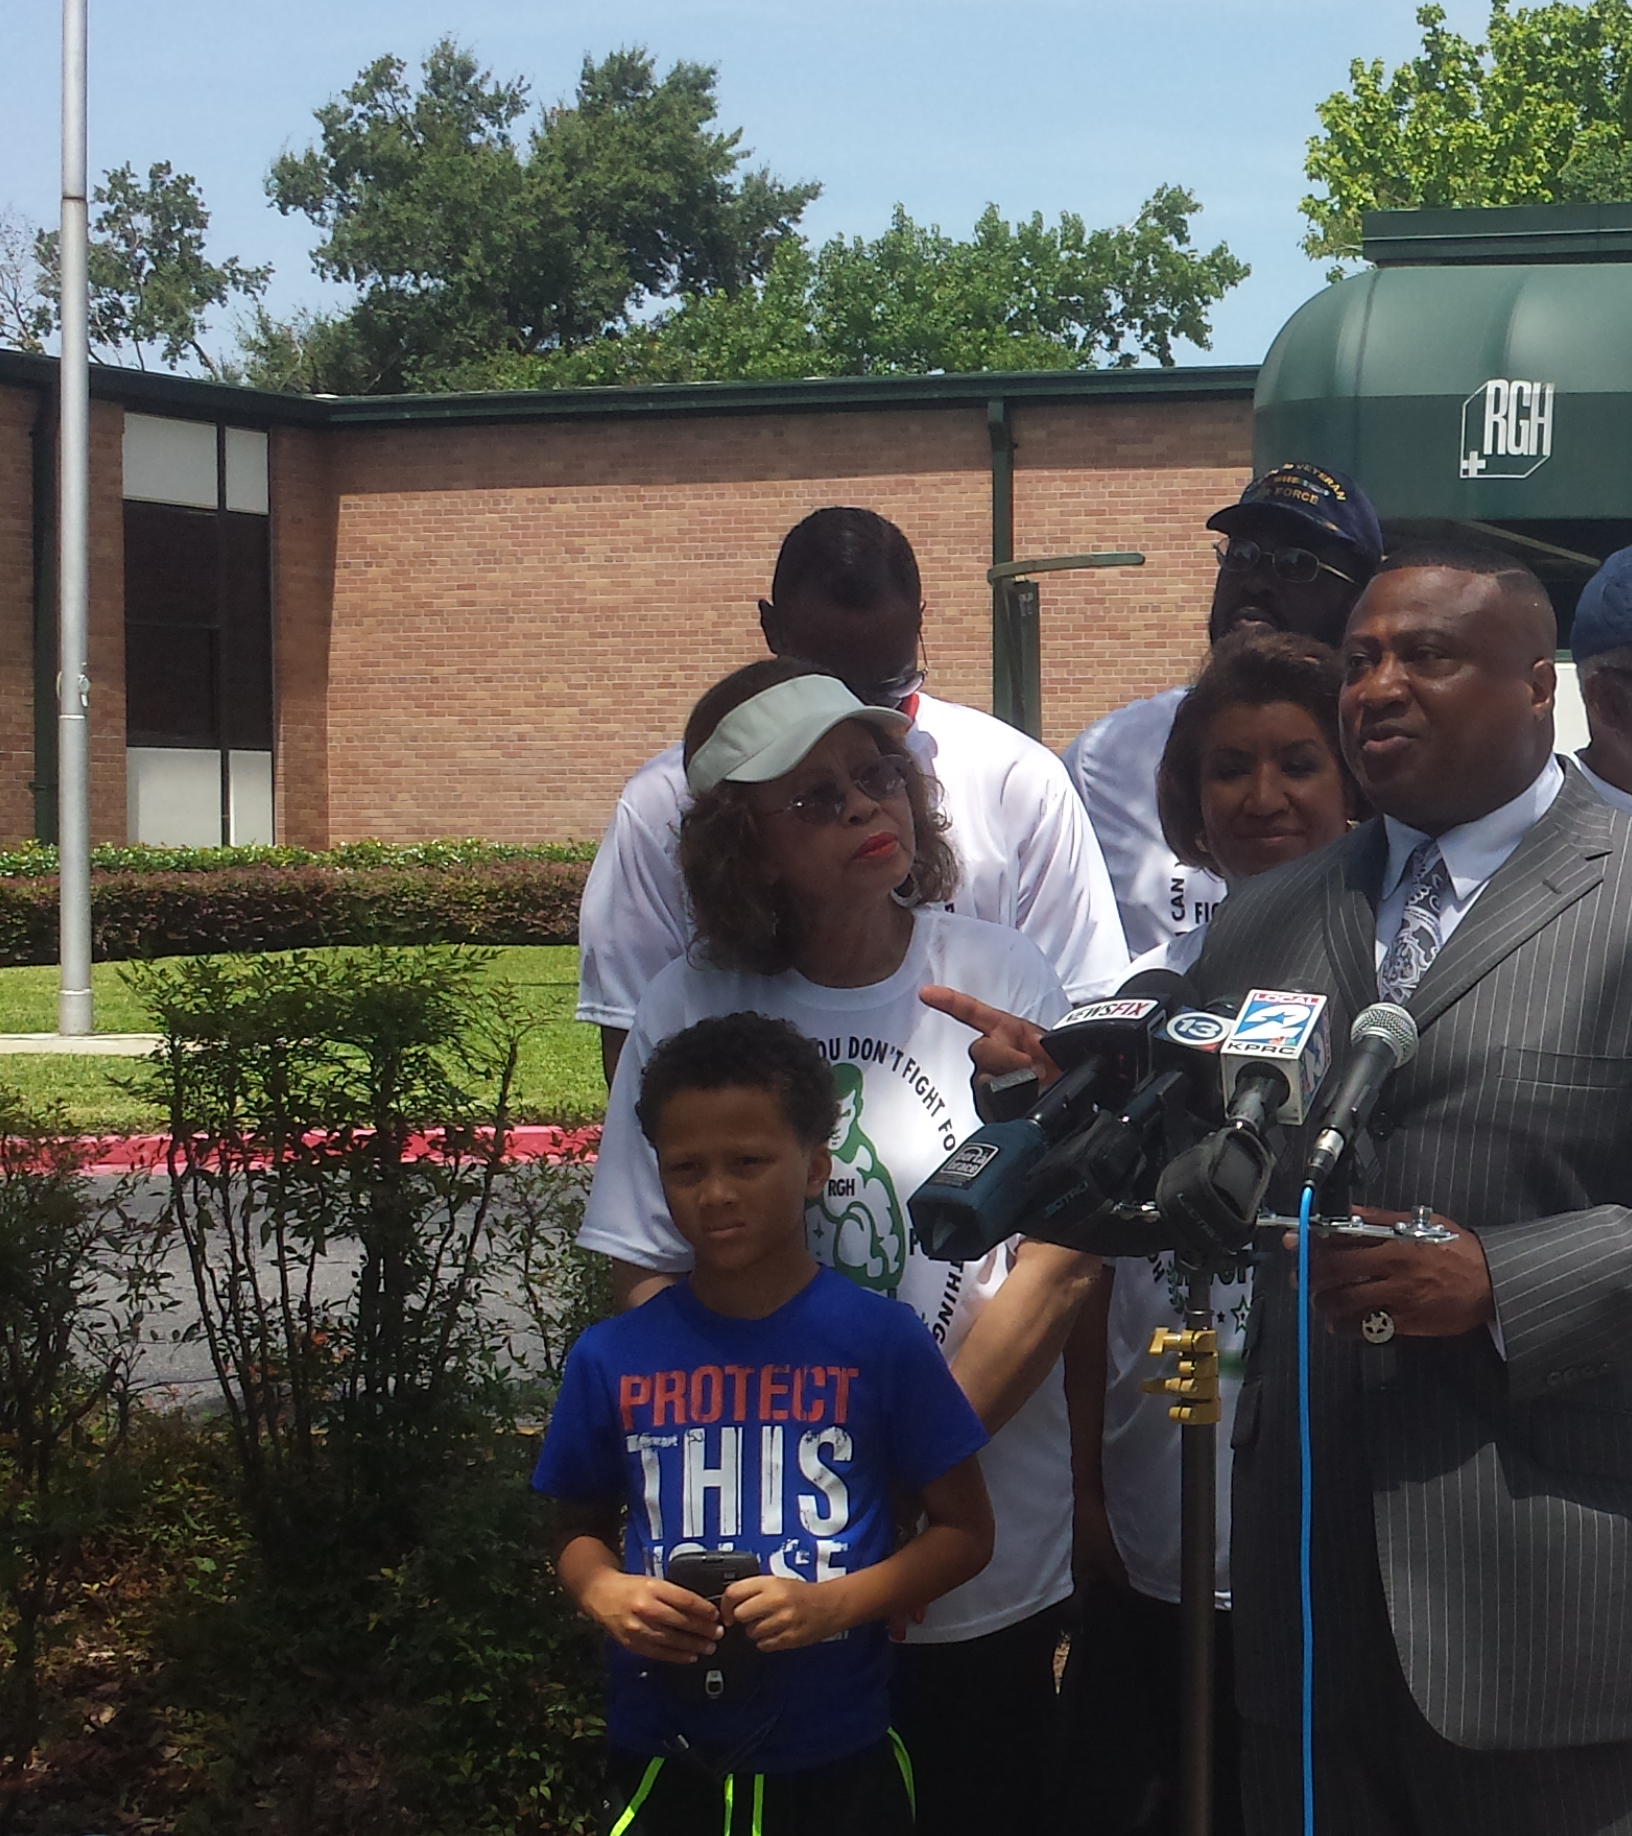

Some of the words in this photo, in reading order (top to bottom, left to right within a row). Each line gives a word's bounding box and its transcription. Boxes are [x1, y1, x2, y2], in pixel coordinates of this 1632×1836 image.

[1483, 379, 1555, 456] RGH
[1275, 486, 1319, 506] FORCE
[1296, 463, 1347, 501] VETERAN
[1254, 993, 1319, 1005] LOCAL
[1178, 1018, 1220, 1038] 13
[1227, 1042, 1297, 1055] KPRC
[848, 1036, 904, 1072] DON'T
[902, 1057, 945, 1117] FIGHT
[828, 1178, 855, 1197] RGH
[619, 1364, 859, 1430] PROTECT
[626, 1425, 854, 1540] THIS
